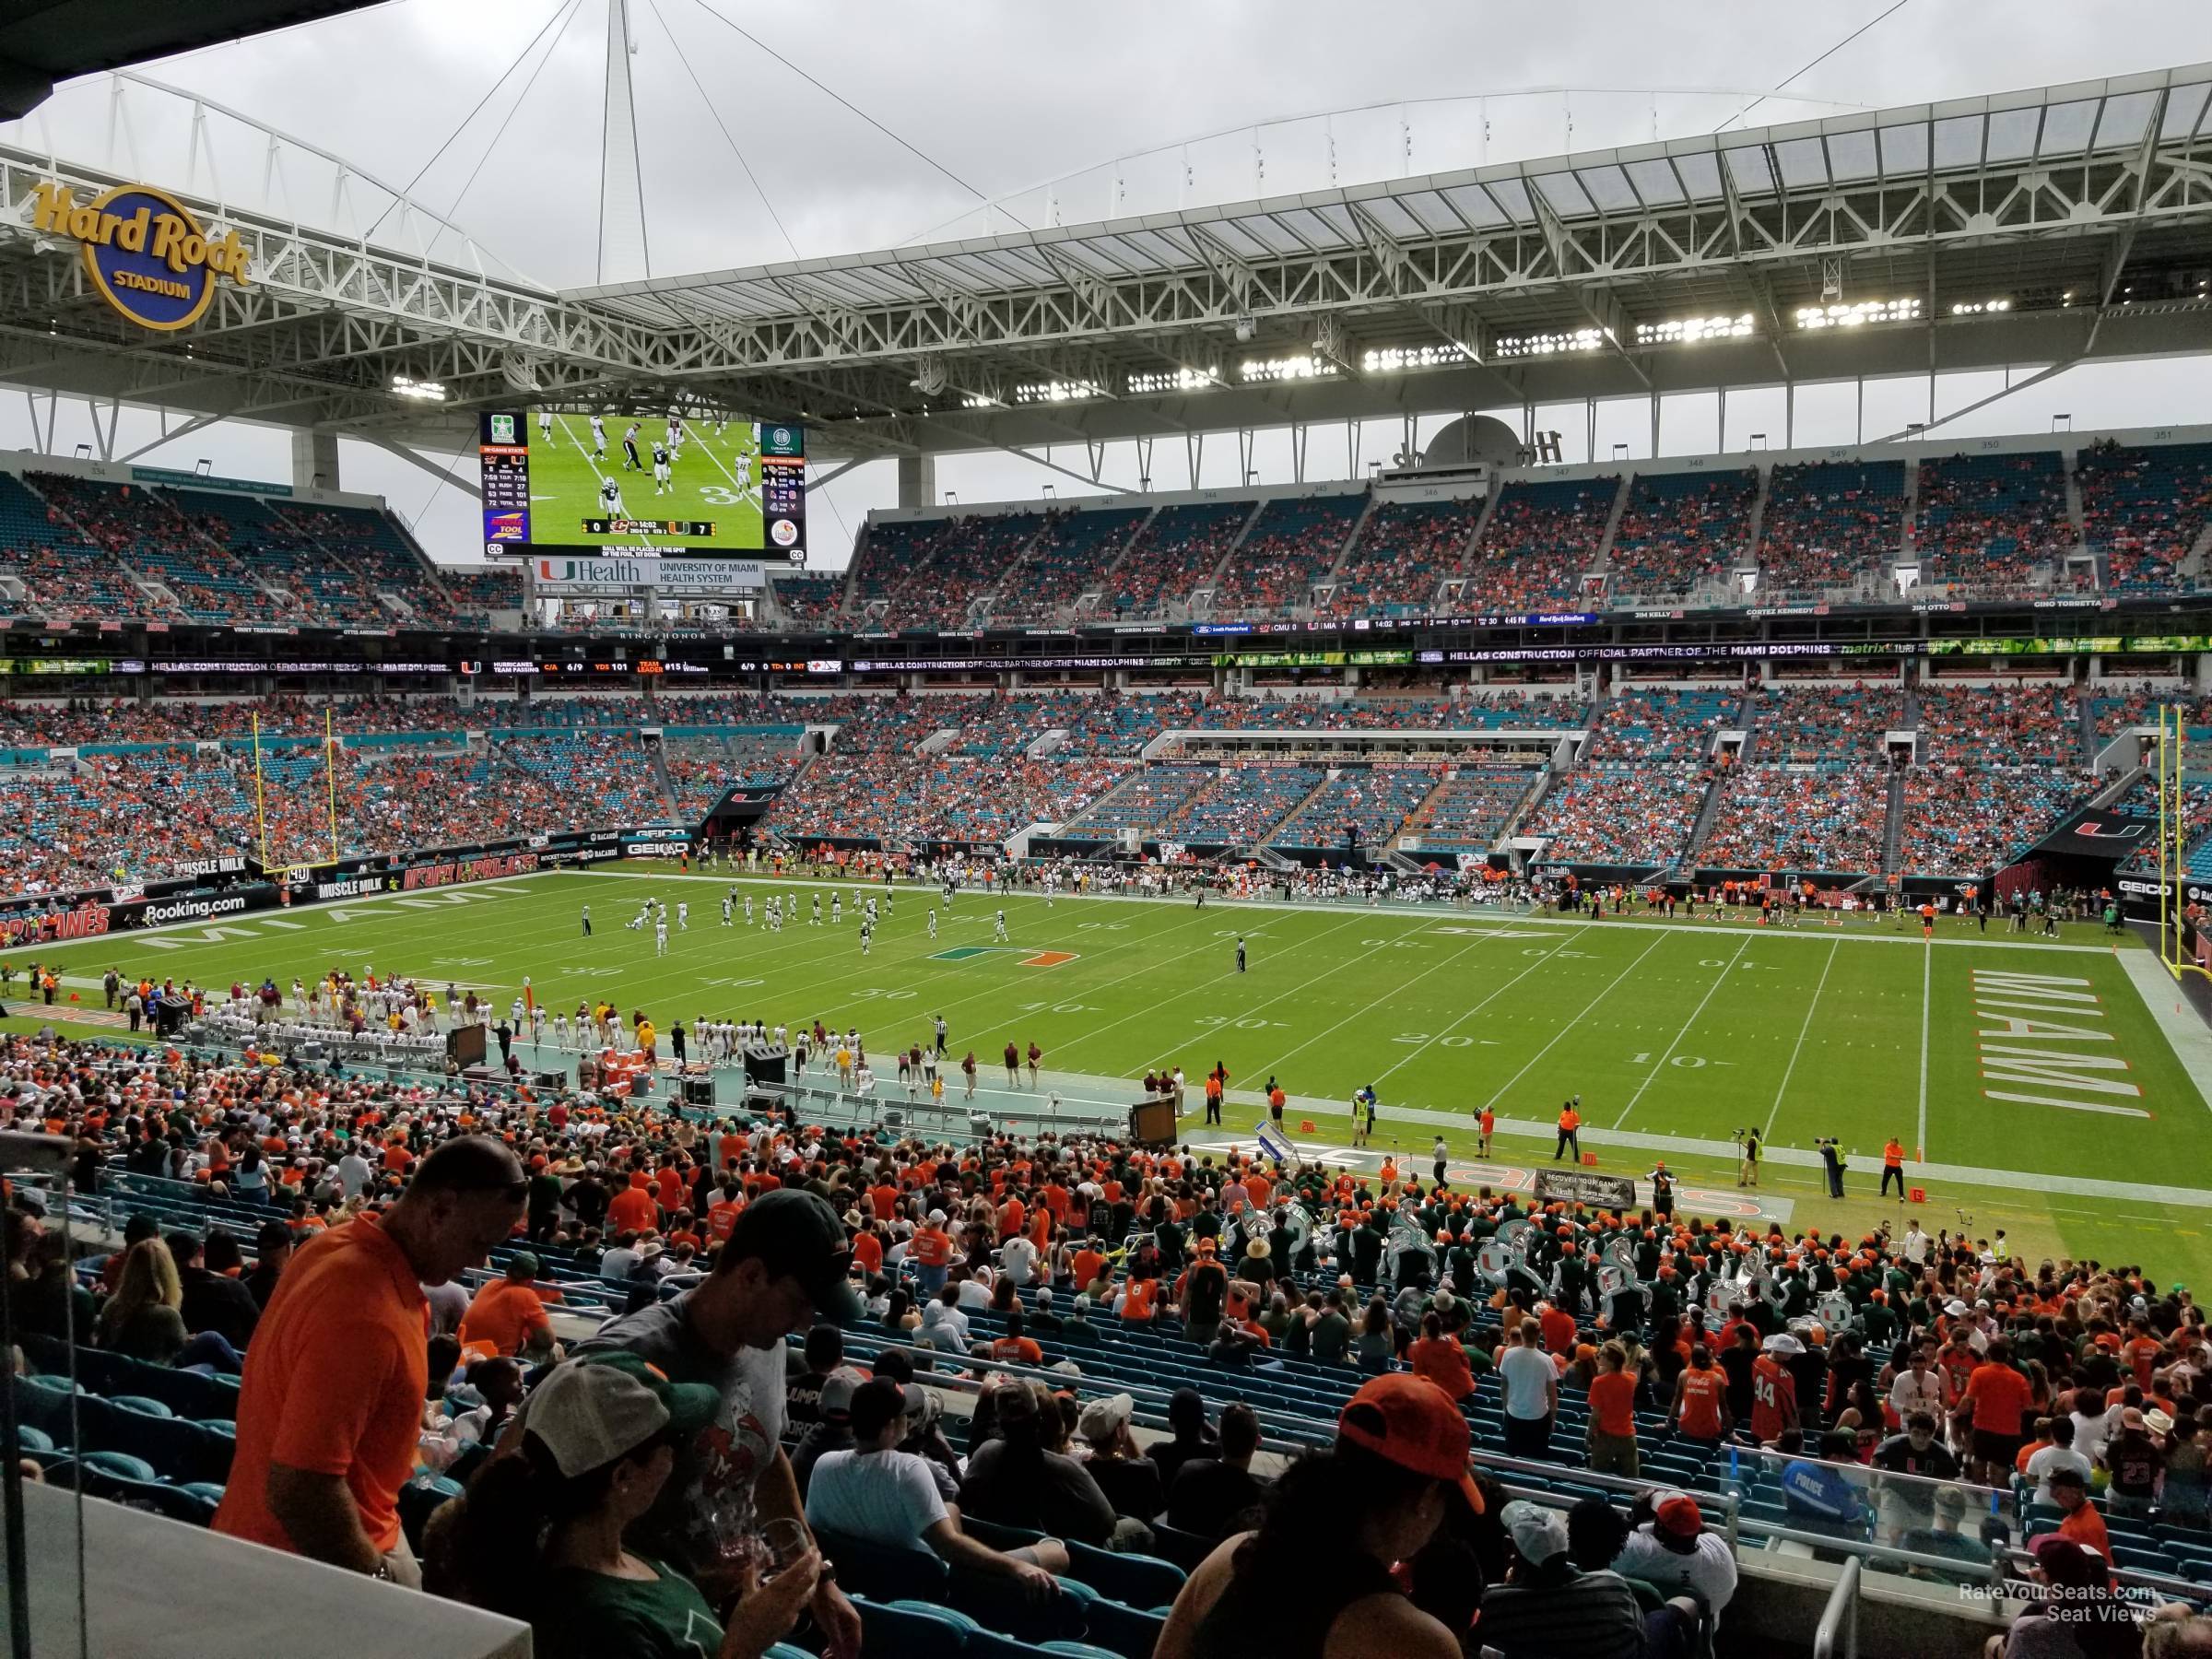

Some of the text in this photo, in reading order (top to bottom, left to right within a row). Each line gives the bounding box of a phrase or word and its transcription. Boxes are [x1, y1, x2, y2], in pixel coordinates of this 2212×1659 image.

[33, 182, 250, 287] Hard Rock
[113, 271, 191, 300] STADIUM
[1982, 441, 1999, 450] 350
[1830, 450, 1847, 458] 349
[1688, 459, 1703, 467] 348
[1555, 468, 1571, 477] 347
[593, 523, 600, 532] 0
[700, 524, 705, 535] 7
[660, 562, 759, 573] UNIVERSITY OF MIAMI
[660, 573, 733, 583] HEALTH SYSTEM
[1565, 615, 1584, 623] Stadium
[1450, 652, 1488, 661] HELLAS
[1492, 650, 1575, 660] CONSTRUCTION
[1578, 649, 1627, 658] OFFICIAL
[1631, 648, 1682, 657] PARTNER
[1686, 648, 1701, 656] OF
[1706, 647, 1727, 655] THE
[1731, 646, 1767, 655] MIAMI
[1770, 645, 1830, 654] DOLPHINS
[1841, 643, 1887, 653] matrix
[152, 663, 191, 672] HELLAS
[194, 663, 267, 672] CONSTRUCTION
[366, 663, 380, 671] THE
[567, 663, 582, 672] 6/9
[612, 663, 628, 671] 101
[741, 663, 755, 671] 6/9
[876, 661, 904, 669] HELLAS
[906, 661, 966, 669] CONSTRUCTION
[967, 660, 1003, 668] OFFICIAL
[174, 857, 246, 875] MUSCLE MILK
[319, 878, 382, 900] MUSCLE MILK
[2118, 880, 2172, 896] GEICO
[146, 896, 245, 921] Booking.com
[134, 886, 532, 949] MIAMI
[850, 988, 918, 999] 50
[1018, 1002, 1085, 1013] 40
[1194, 1015, 1268, 1029] 30
[1392, 1032, 1474, 1048] 20
[1971, 971, 2155, 1118] MIAMI
[1625, 1053, 1707, 1068] 10
[1343, 1179, 1350, 1190] 8
[1914, 1190, 1922, 1200] G
[1133, 1283, 1142, 1296] 8
[1825, 1309, 1846, 1322] U
[1686, 1376, 1711, 1387] Coca-Cola
[1754, 1374, 1775, 1409] 44
[1795, 1472, 1823, 1497] POLICE
